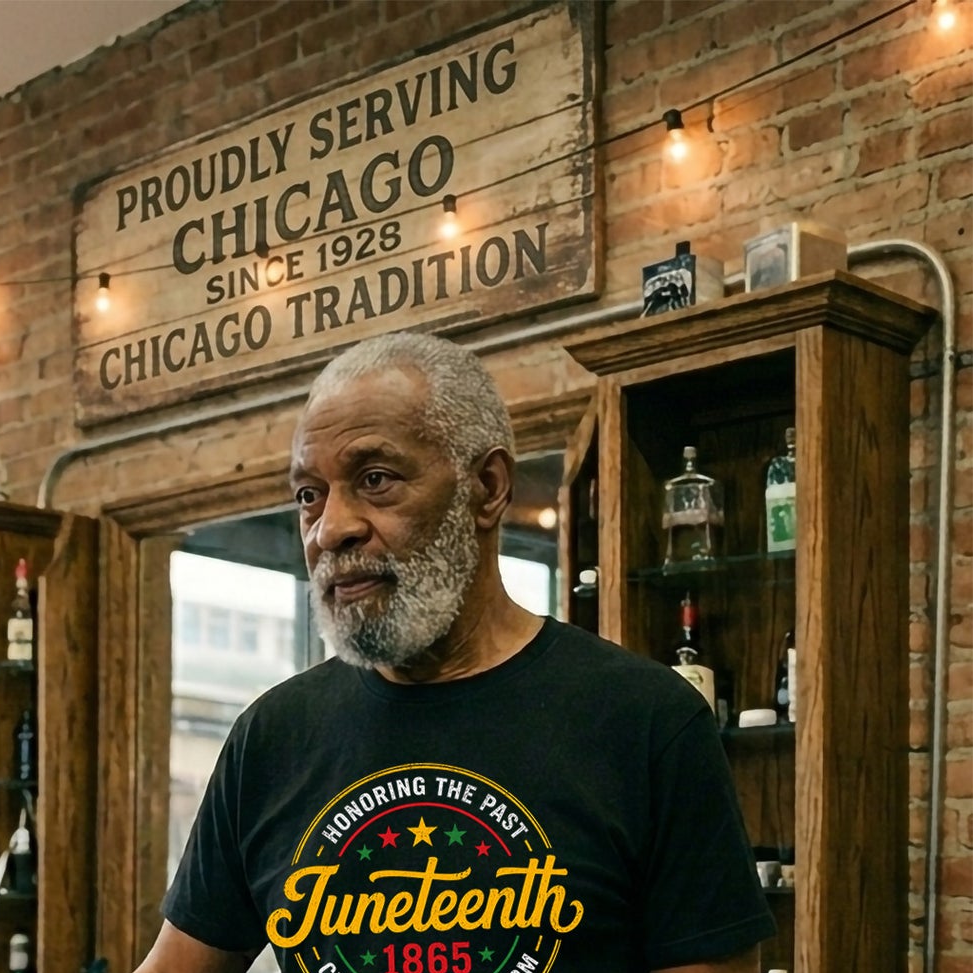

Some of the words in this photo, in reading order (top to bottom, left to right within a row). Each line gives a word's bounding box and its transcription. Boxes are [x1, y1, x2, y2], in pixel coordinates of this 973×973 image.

[116, 123, 295, 232] PROUDLY
[309, 39, 517, 160] SERVING
[172, 135, 454, 274] CHICAGO
[99, 305, 271, 390] CHICAGO
[287, 223, 548, 339] TRADITION
[206, 250, 304, 304] SINCE
[317, 222, 401, 272] 1928
[322, 776, 426, 844] HONORING
[436, 777, 476, 804] THE
[480, 793, 528, 839] PAST
[266, 854, 584, 948] Juneteenth
